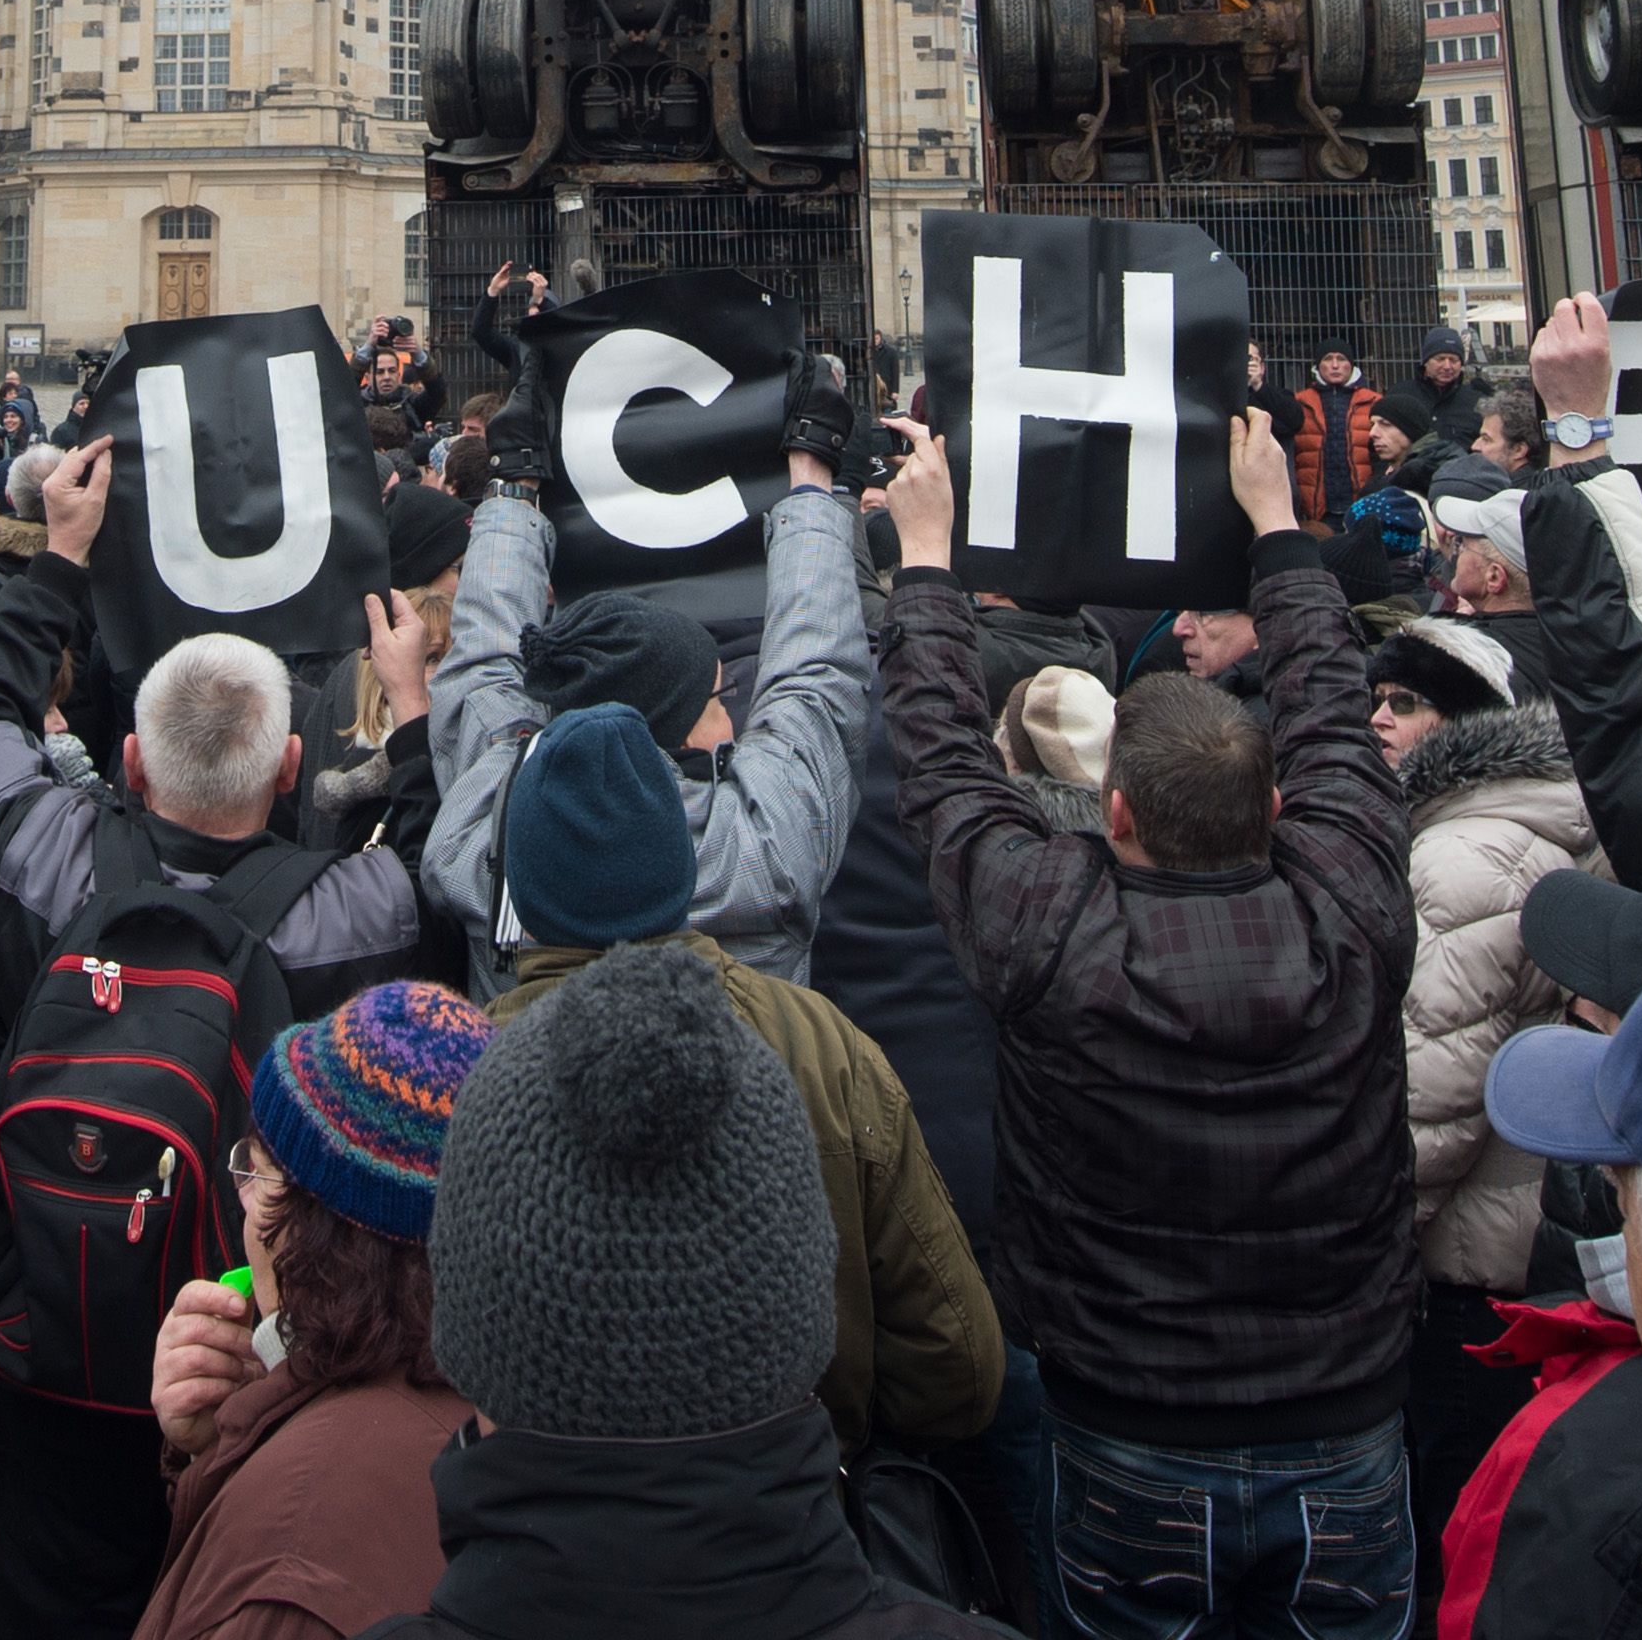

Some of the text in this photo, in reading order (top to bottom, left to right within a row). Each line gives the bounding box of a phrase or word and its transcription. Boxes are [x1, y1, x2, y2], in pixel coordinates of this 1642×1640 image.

[135, 351, 332, 614] U
[562, 328, 750, 549] C
[967, 255, 1178, 562] H
